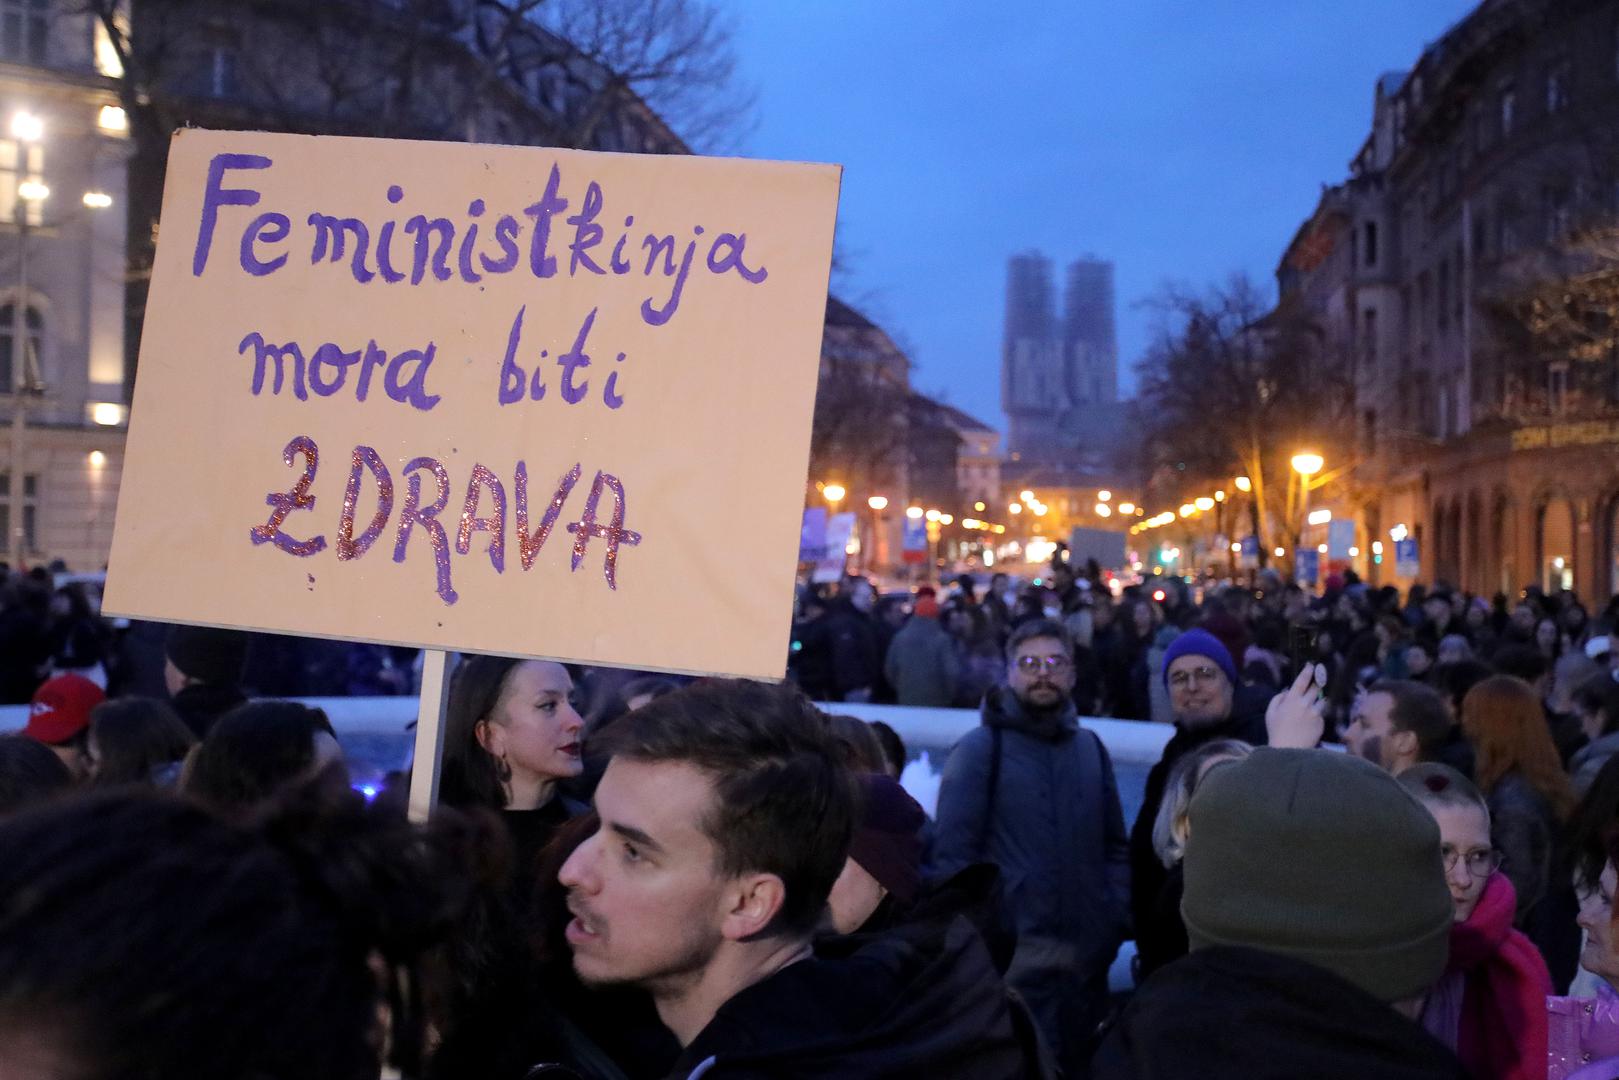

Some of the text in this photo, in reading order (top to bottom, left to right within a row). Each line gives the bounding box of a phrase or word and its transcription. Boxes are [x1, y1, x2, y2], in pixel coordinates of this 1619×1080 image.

[192, 152, 769, 327] Feministkinja
[239, 305, 628, 412] mora biti
[249, 435, 642, 606] ZDRAVA
